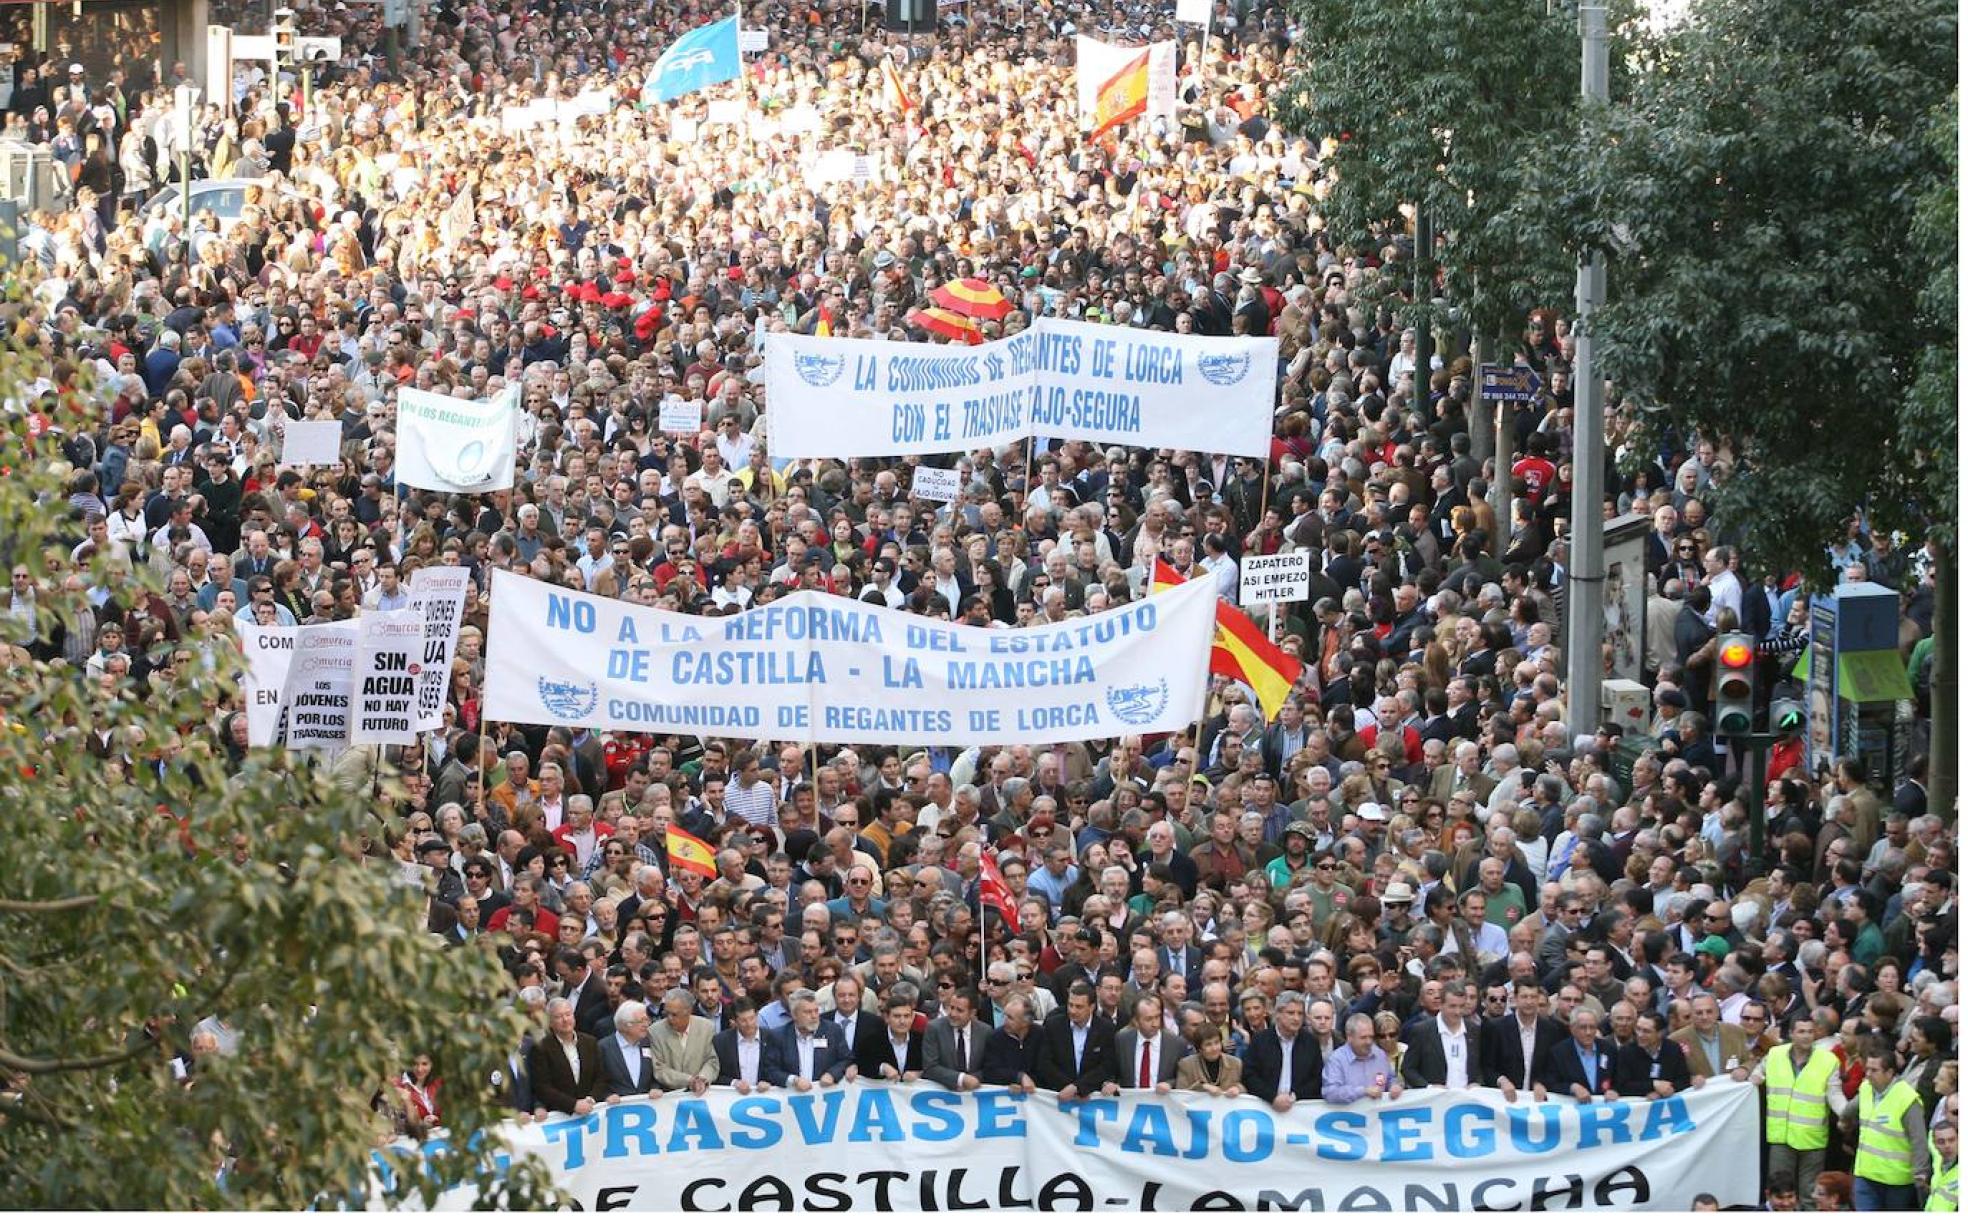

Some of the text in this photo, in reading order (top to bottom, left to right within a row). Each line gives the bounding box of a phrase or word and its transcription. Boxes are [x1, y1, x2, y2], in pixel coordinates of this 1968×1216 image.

[854, 354, 876, 391] LA
[887, 353, 981, 393] COMUNIDAD
[1007, 331, 1083, 377] REGANTES
[1092, 339, 1117, 378] DE
[1125, 343, 1183, 385] LORCA
[892, 403, 925, 444] CON
[934, 404, 951, 441] EL
[961, 389, 1023, 439] TRASVASE
[1248, 556, 1303, 570] ZAPATERO
[1243, 571, 1308, 586] ASI EMPEZO
[1256, 587, 1294, 600] HITLER
[546, 592, 1157, 654] NO A LA REFORMA DEL ESTATUTO
[258, 634, 295, 650] COM
[374, 651, 407, 671] SIN
[607, 649, 650, 683] DE
[672, 650, 826, 686] CASTILLA
[884, 655, 924, 689] LA
[947, 655, 1096, 690] MANCHA
[314, 680, 331, 690] LOS
[362, 676, 415, 696] AGUA
[256, 690, 278, 705] EN
[364, 700, 410, 712] NO HAY
[296, 713, 345, 726] POR LOS
[608, 699, 760, 728] COMUNIDAD
[778, 705, 809, 728] DE
[826, 706, 952, 733] REGANTES
[969, 710, 1001, 732] DE
[1018, 703, 1100, 732] LORCA
[361, 718, 409, 731] FUTURO
[293, 728, 346, 740] TRASVASES
[541, 1088, 1028, 1171] TRASVASE
[1057, 1095, 1697, 1164] TAJO-SEGURA
